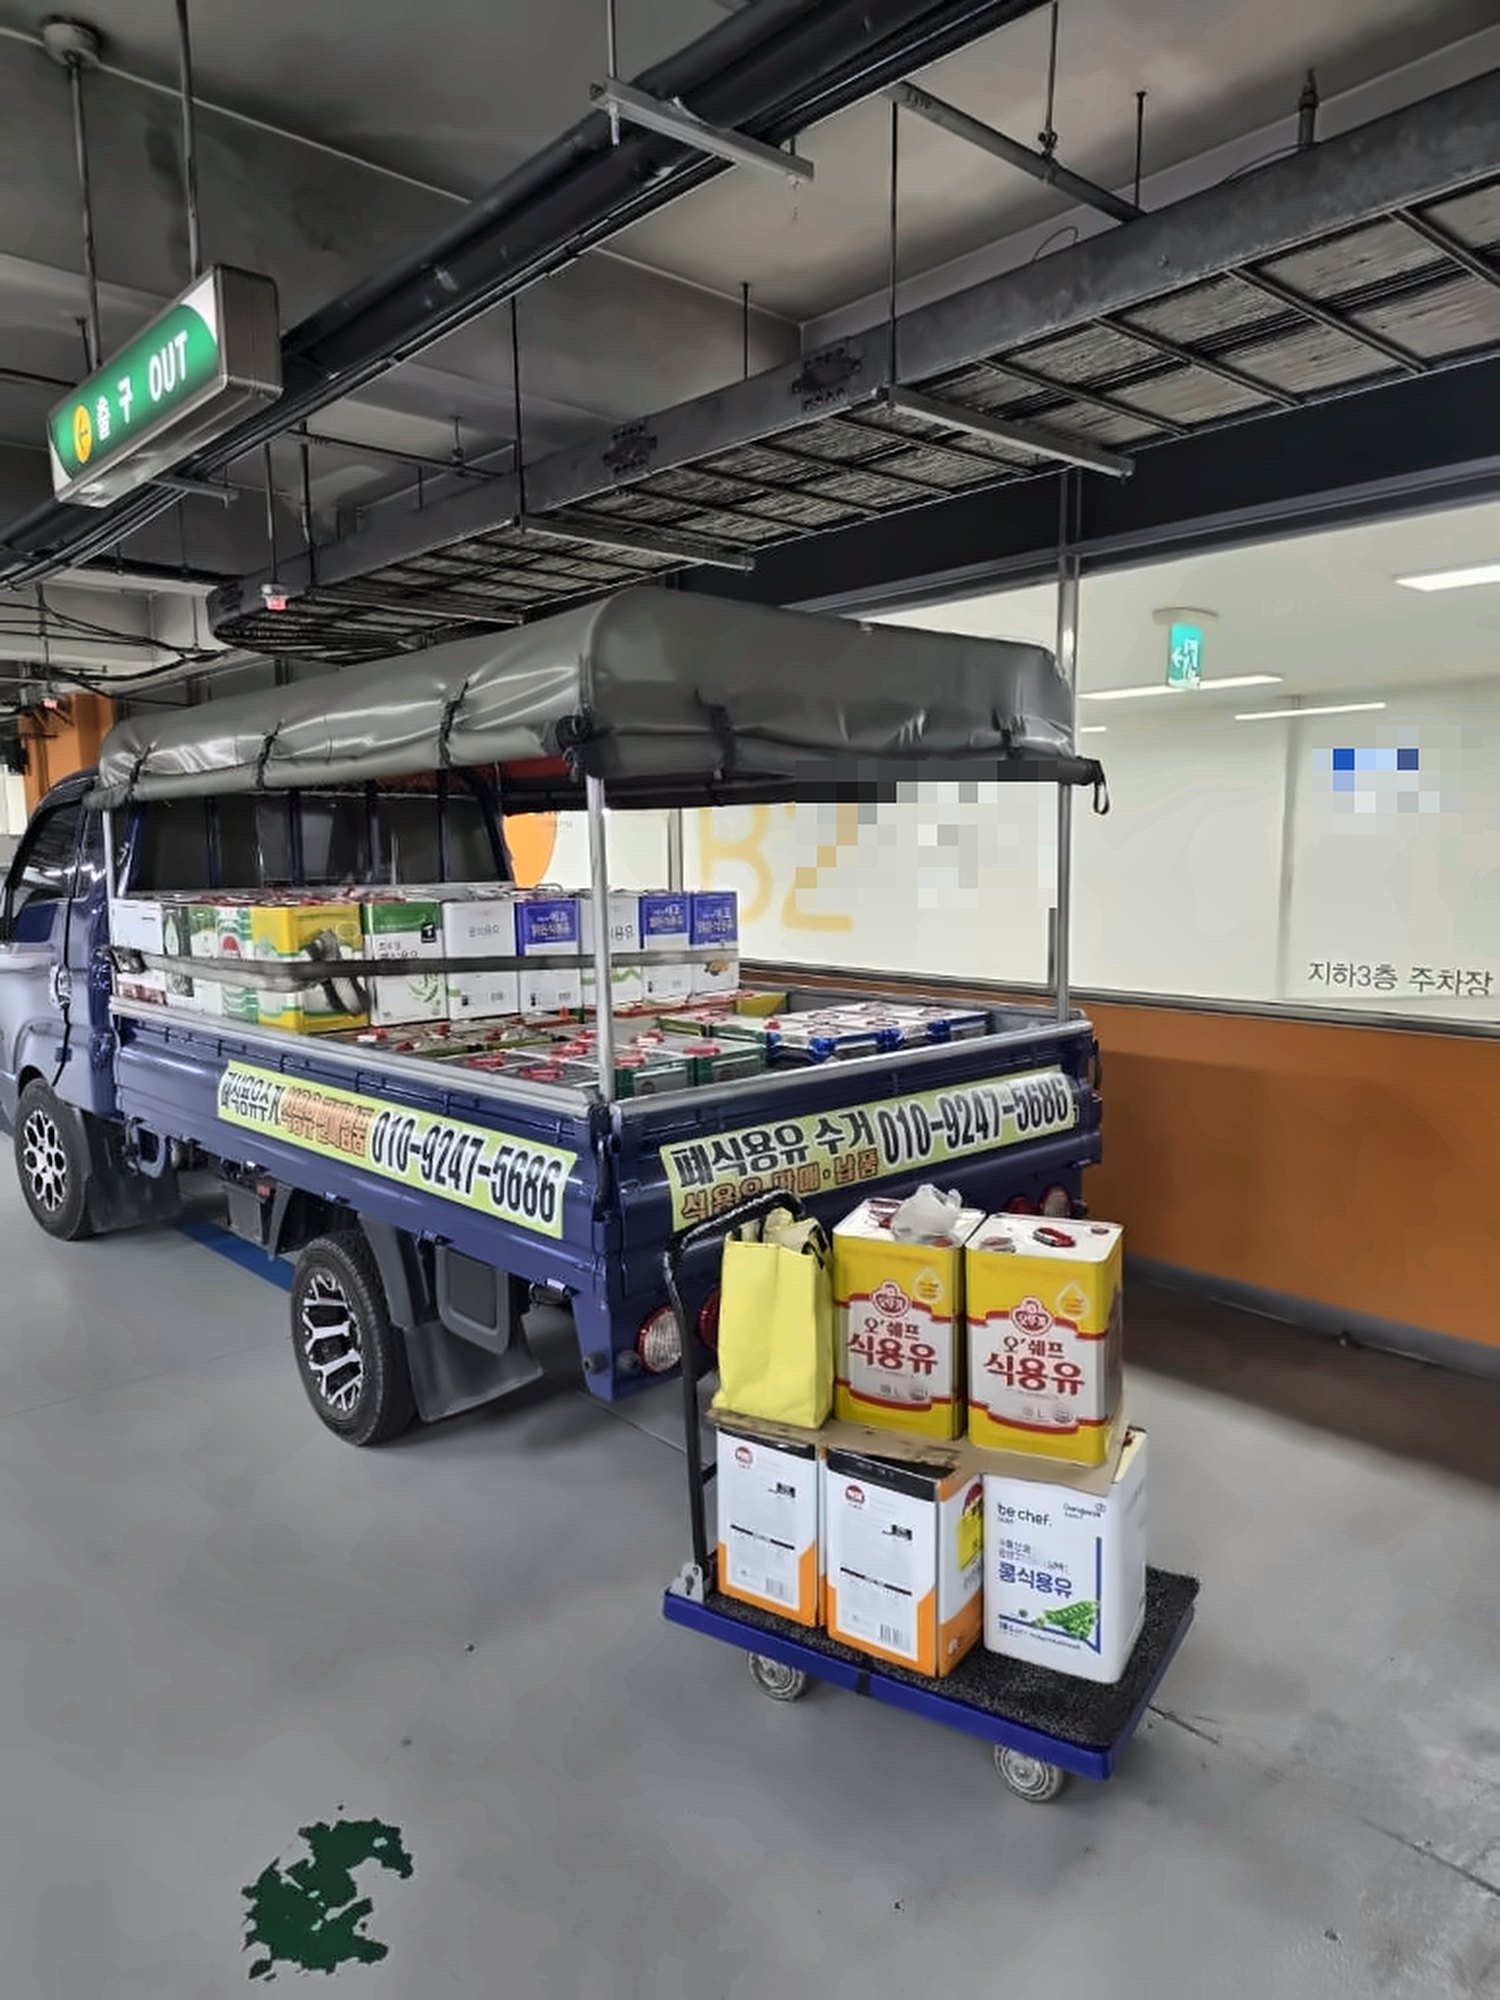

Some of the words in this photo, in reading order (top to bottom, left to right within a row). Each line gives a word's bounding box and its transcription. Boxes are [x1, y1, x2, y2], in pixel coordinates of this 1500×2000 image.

[149, 330, 188, 402] OUT
[1308, 961, 1398, 990] 지하3층
[1408, 966, 1493, 997] 주차장
[671, 1124, 812, 1187] 폐식용유
[815, 1111, 876, 1155] 수거
[878, 1077, 1069, 1165] 010-9247-5686
[372, 1111, 562, 1222] 010-9247-5686
[846, 1333, 938, 1376] 식용유
[984, 1352, 1085, 1396] 식용유
[997, 1503, 1016, 1518] be
[1018, 1509, 1052, 1528] chef.
